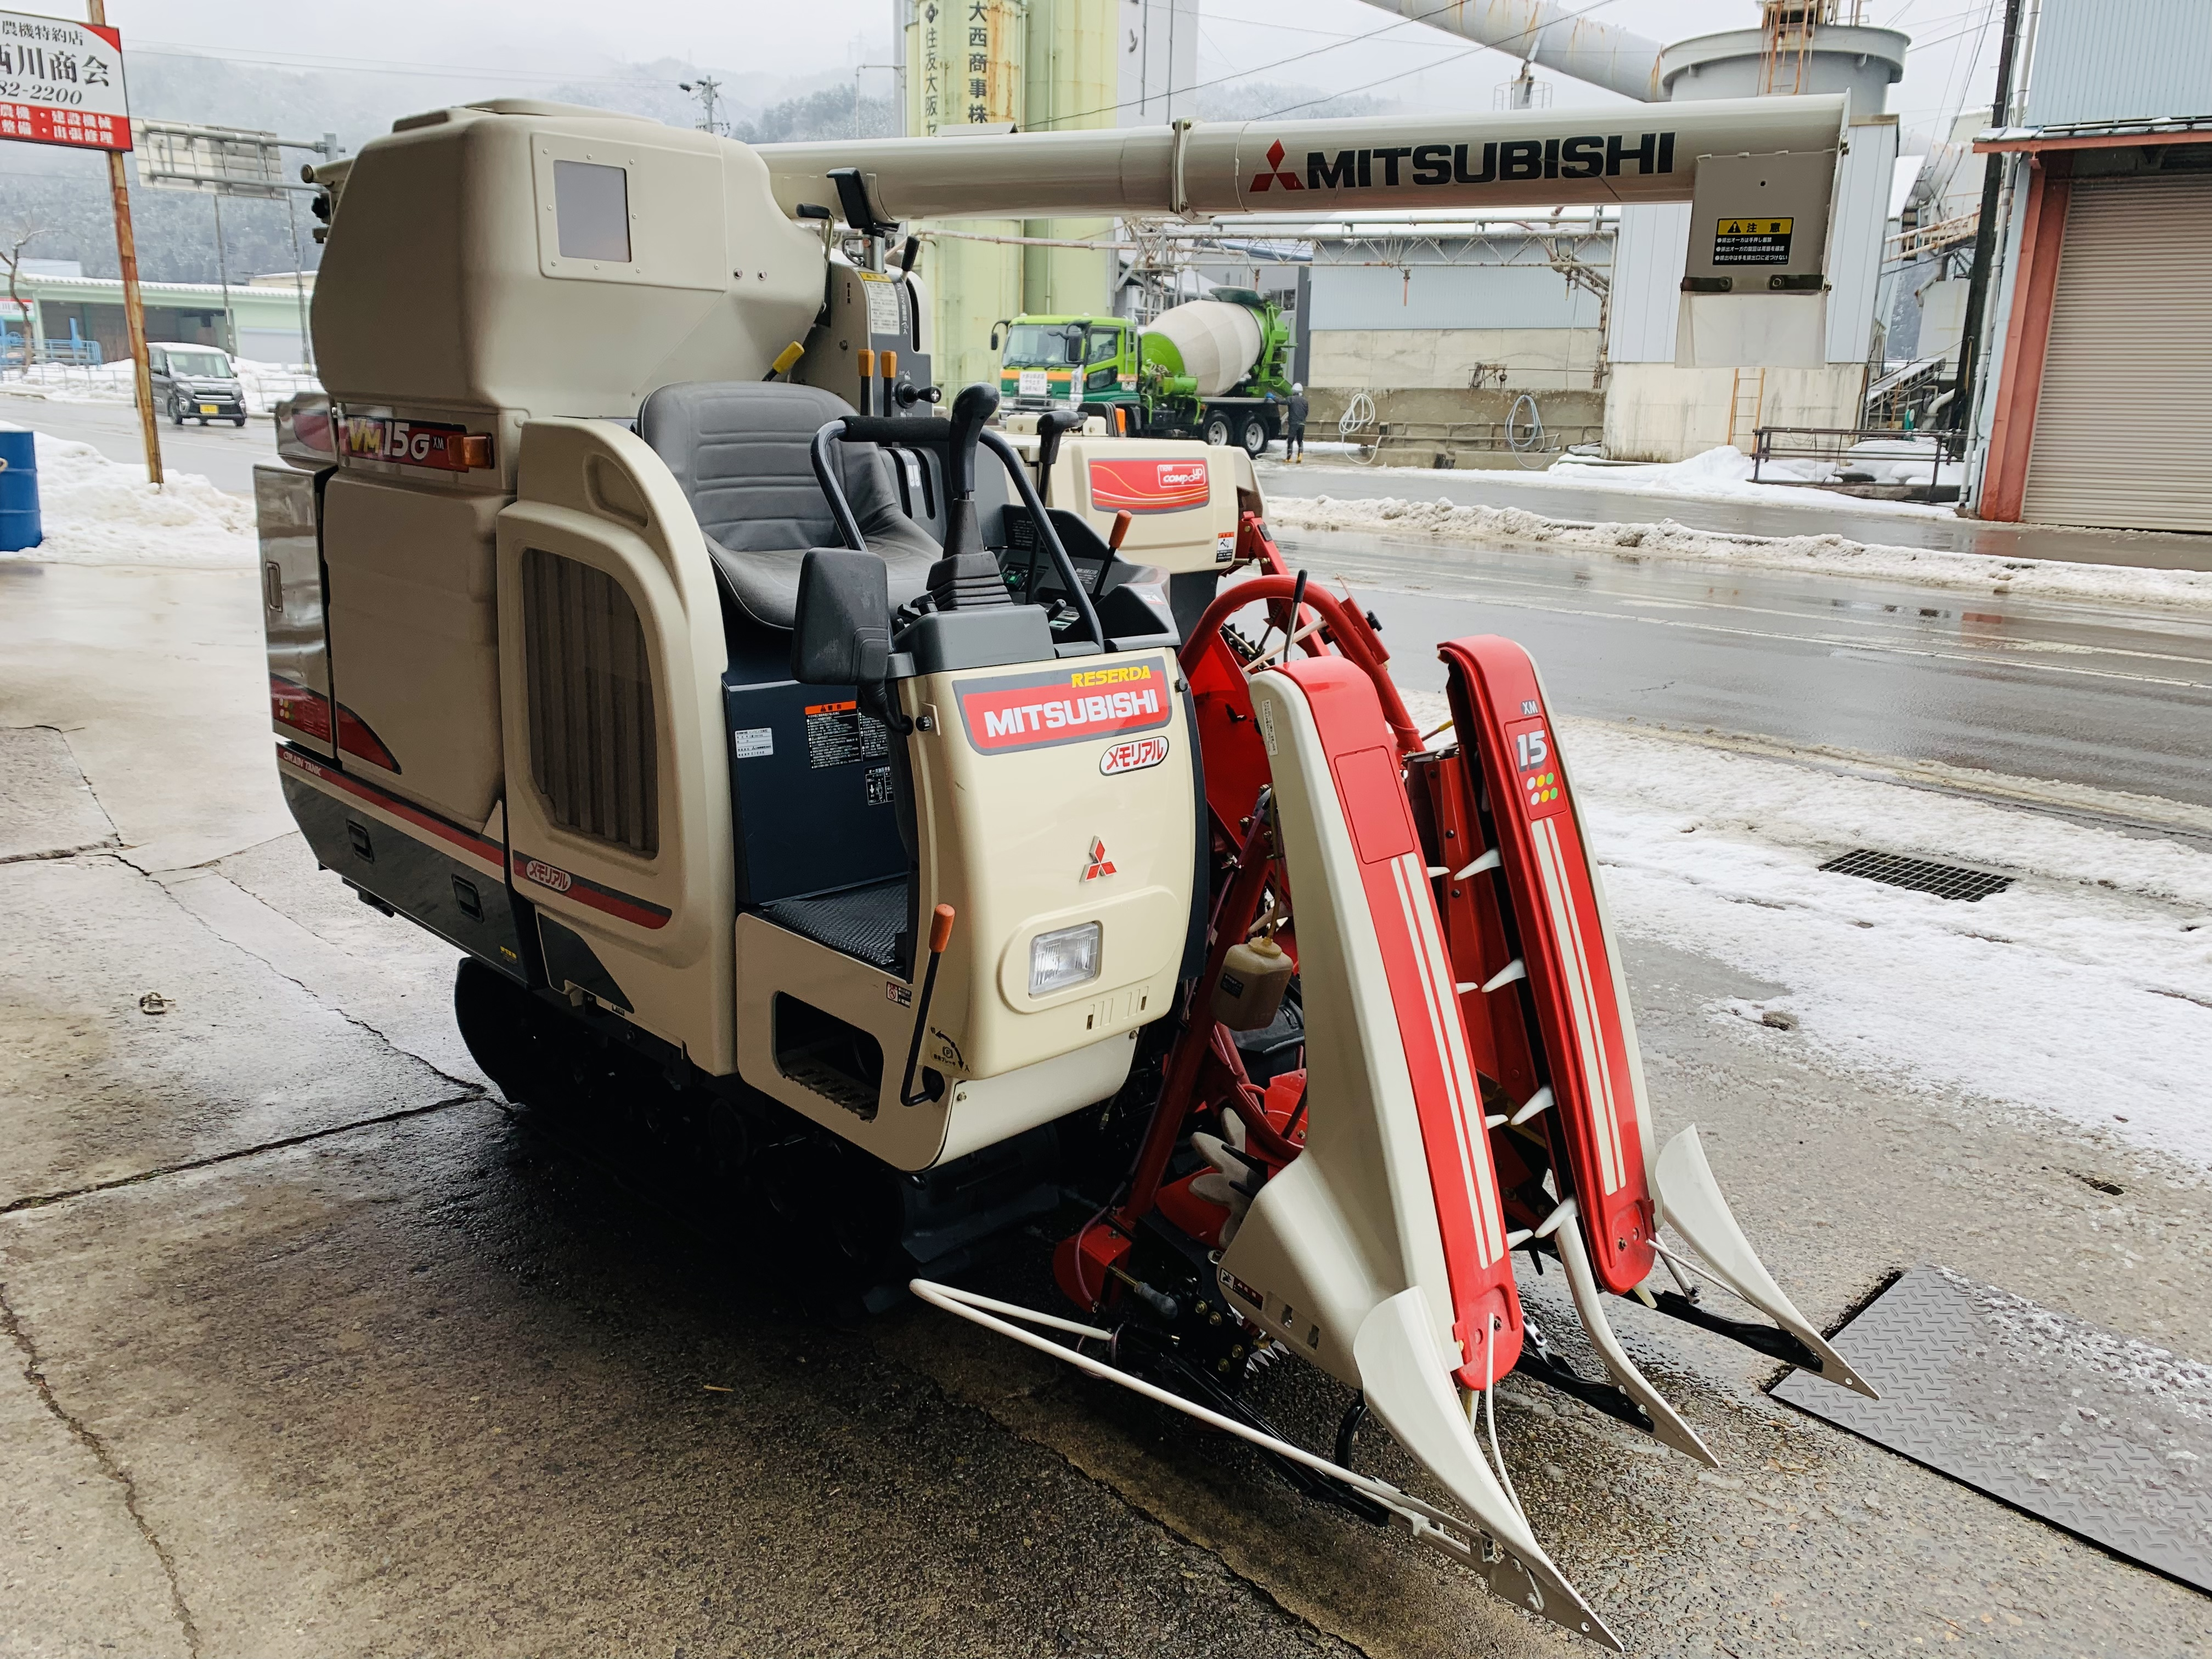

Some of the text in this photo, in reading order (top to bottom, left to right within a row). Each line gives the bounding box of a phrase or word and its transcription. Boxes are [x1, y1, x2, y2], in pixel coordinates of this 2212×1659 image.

[968, 1, 988, 123] 大西商事株
[1306, 132, 1676, 189] MITSUBISHI
[1071, 665, 1152, 689] RESERDA
[984, 689, 1159, 738] MITSUBISHI
[1522, 700, 1538, 715] XM
[1106, 739, 1164, 771] メモリアル
[1517, 730, 1548, 768] 15
[304, 758, 321, 777] TANK
[529, 861, 568, 890] メモリアル
